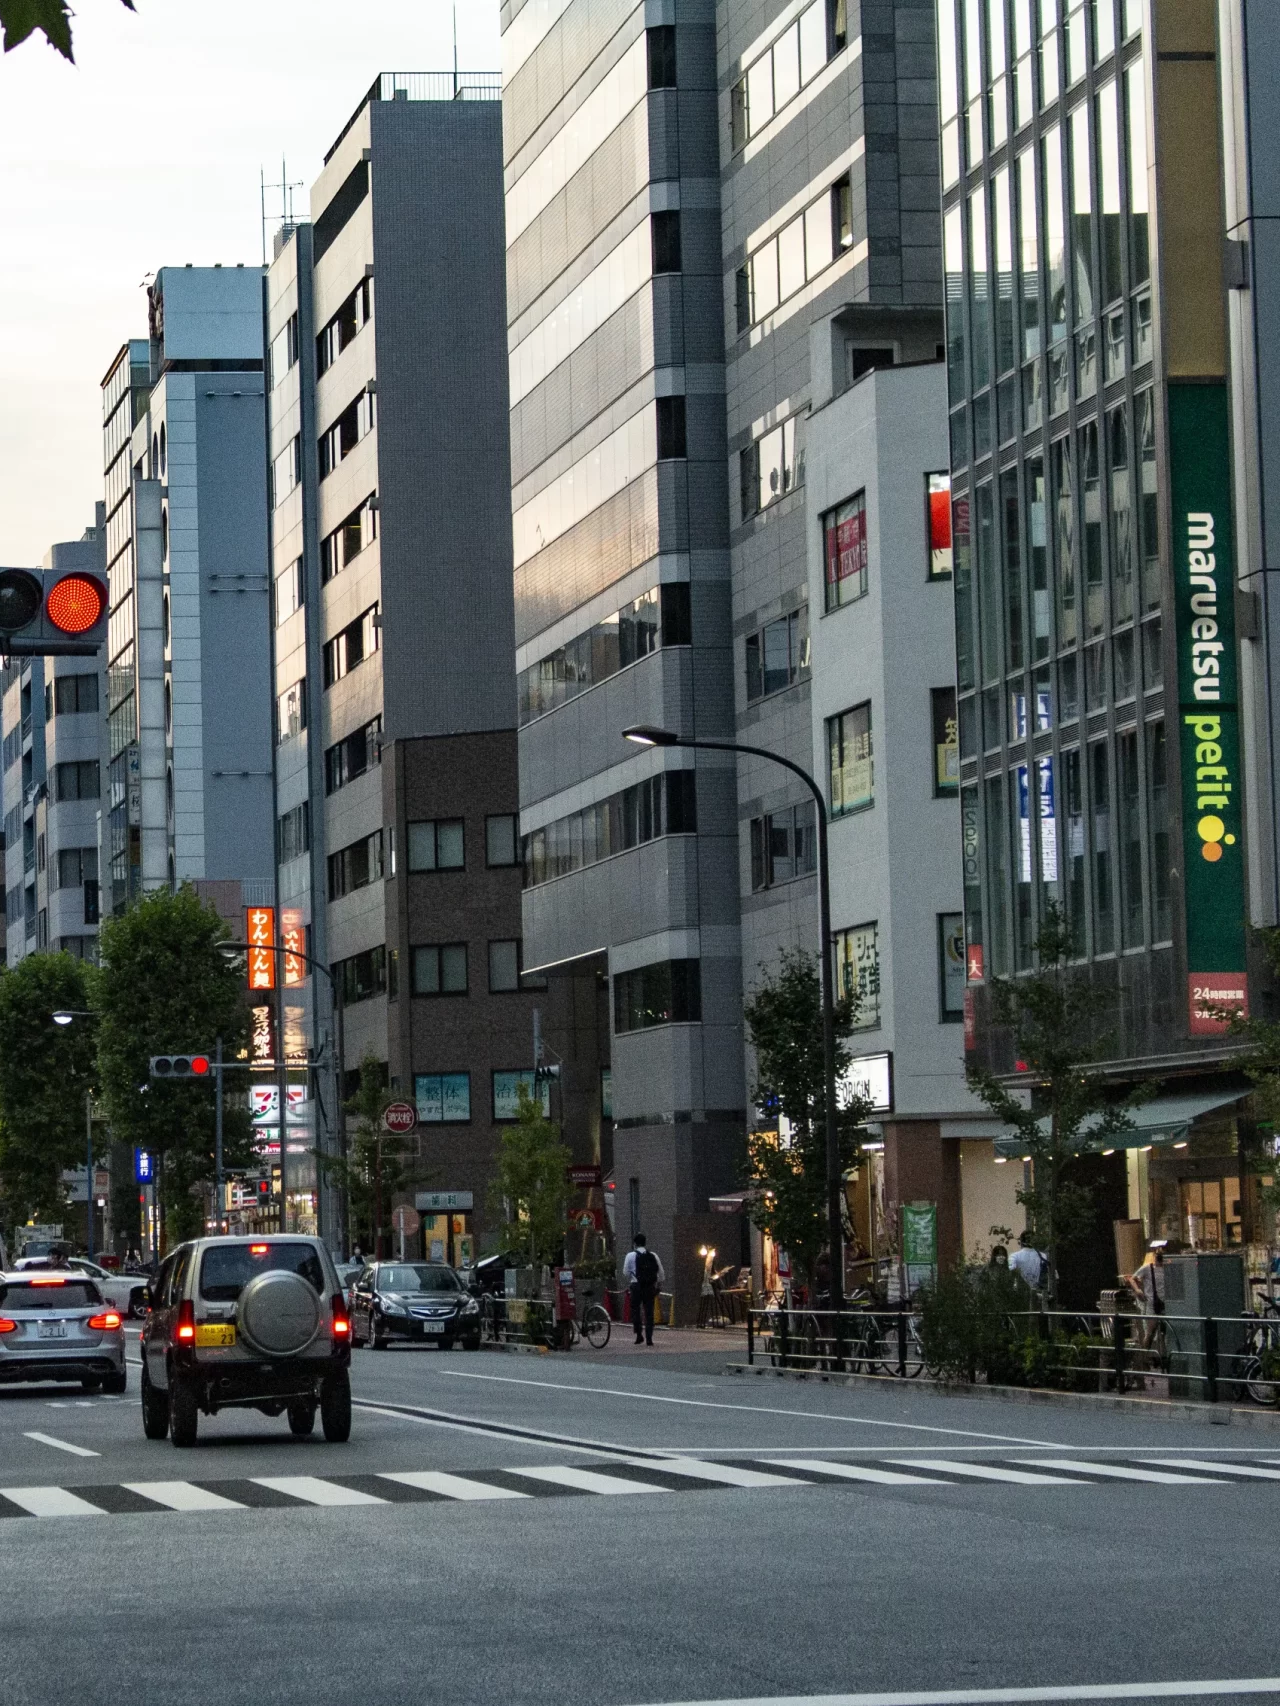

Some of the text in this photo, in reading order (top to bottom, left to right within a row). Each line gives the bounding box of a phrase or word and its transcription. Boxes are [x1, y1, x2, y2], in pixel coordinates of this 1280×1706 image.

[1185, 511, 1225, 701] maruetsu
[1185, 715, 1232, 810] petit
[387, 1112, 412, 1124] 消火栓
